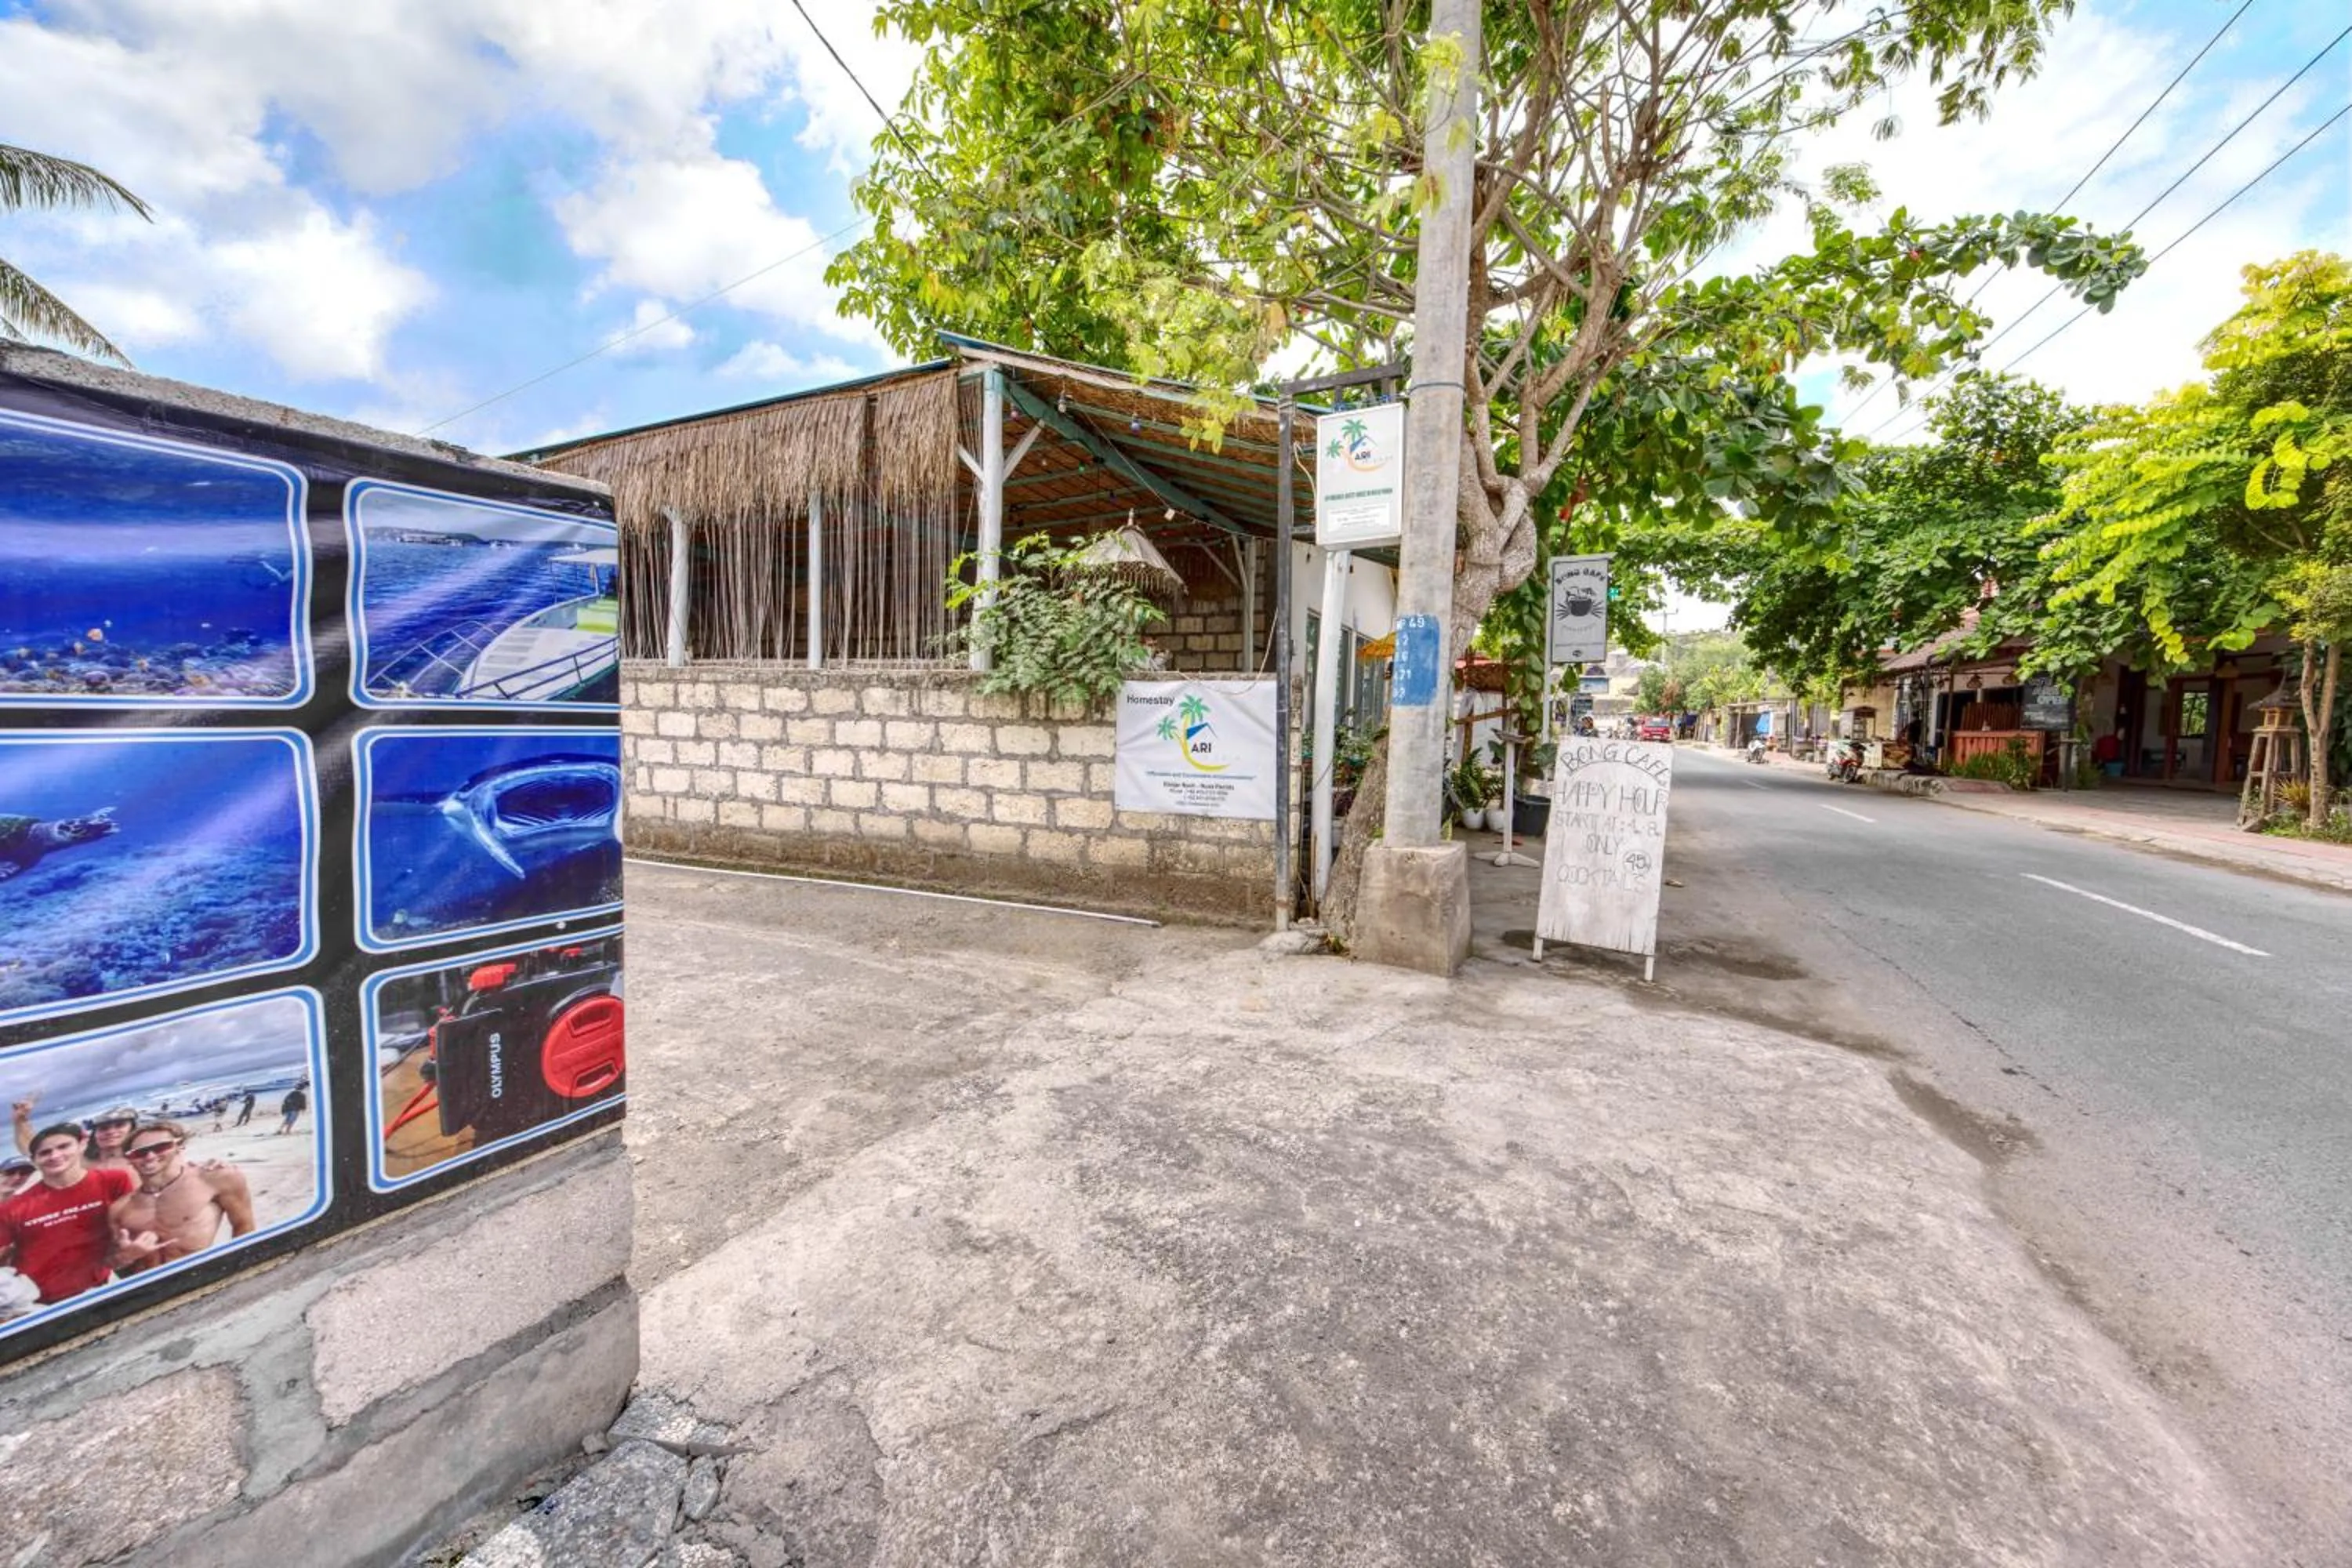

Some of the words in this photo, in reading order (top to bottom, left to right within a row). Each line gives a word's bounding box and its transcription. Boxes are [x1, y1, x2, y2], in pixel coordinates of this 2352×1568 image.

[1127, 695, 1174, 706] Homestay
[1191, 742, 1211, 753] ARI
[1559, 743, 1618, 775] BONG
[1553, 780, 1617, 809] HAPPY
[1620, 783, 1670, 816] HOUR
[1585, 833, 1623, 855] ONLY
[489, 1032, 502, 1098] OLYMPUS
